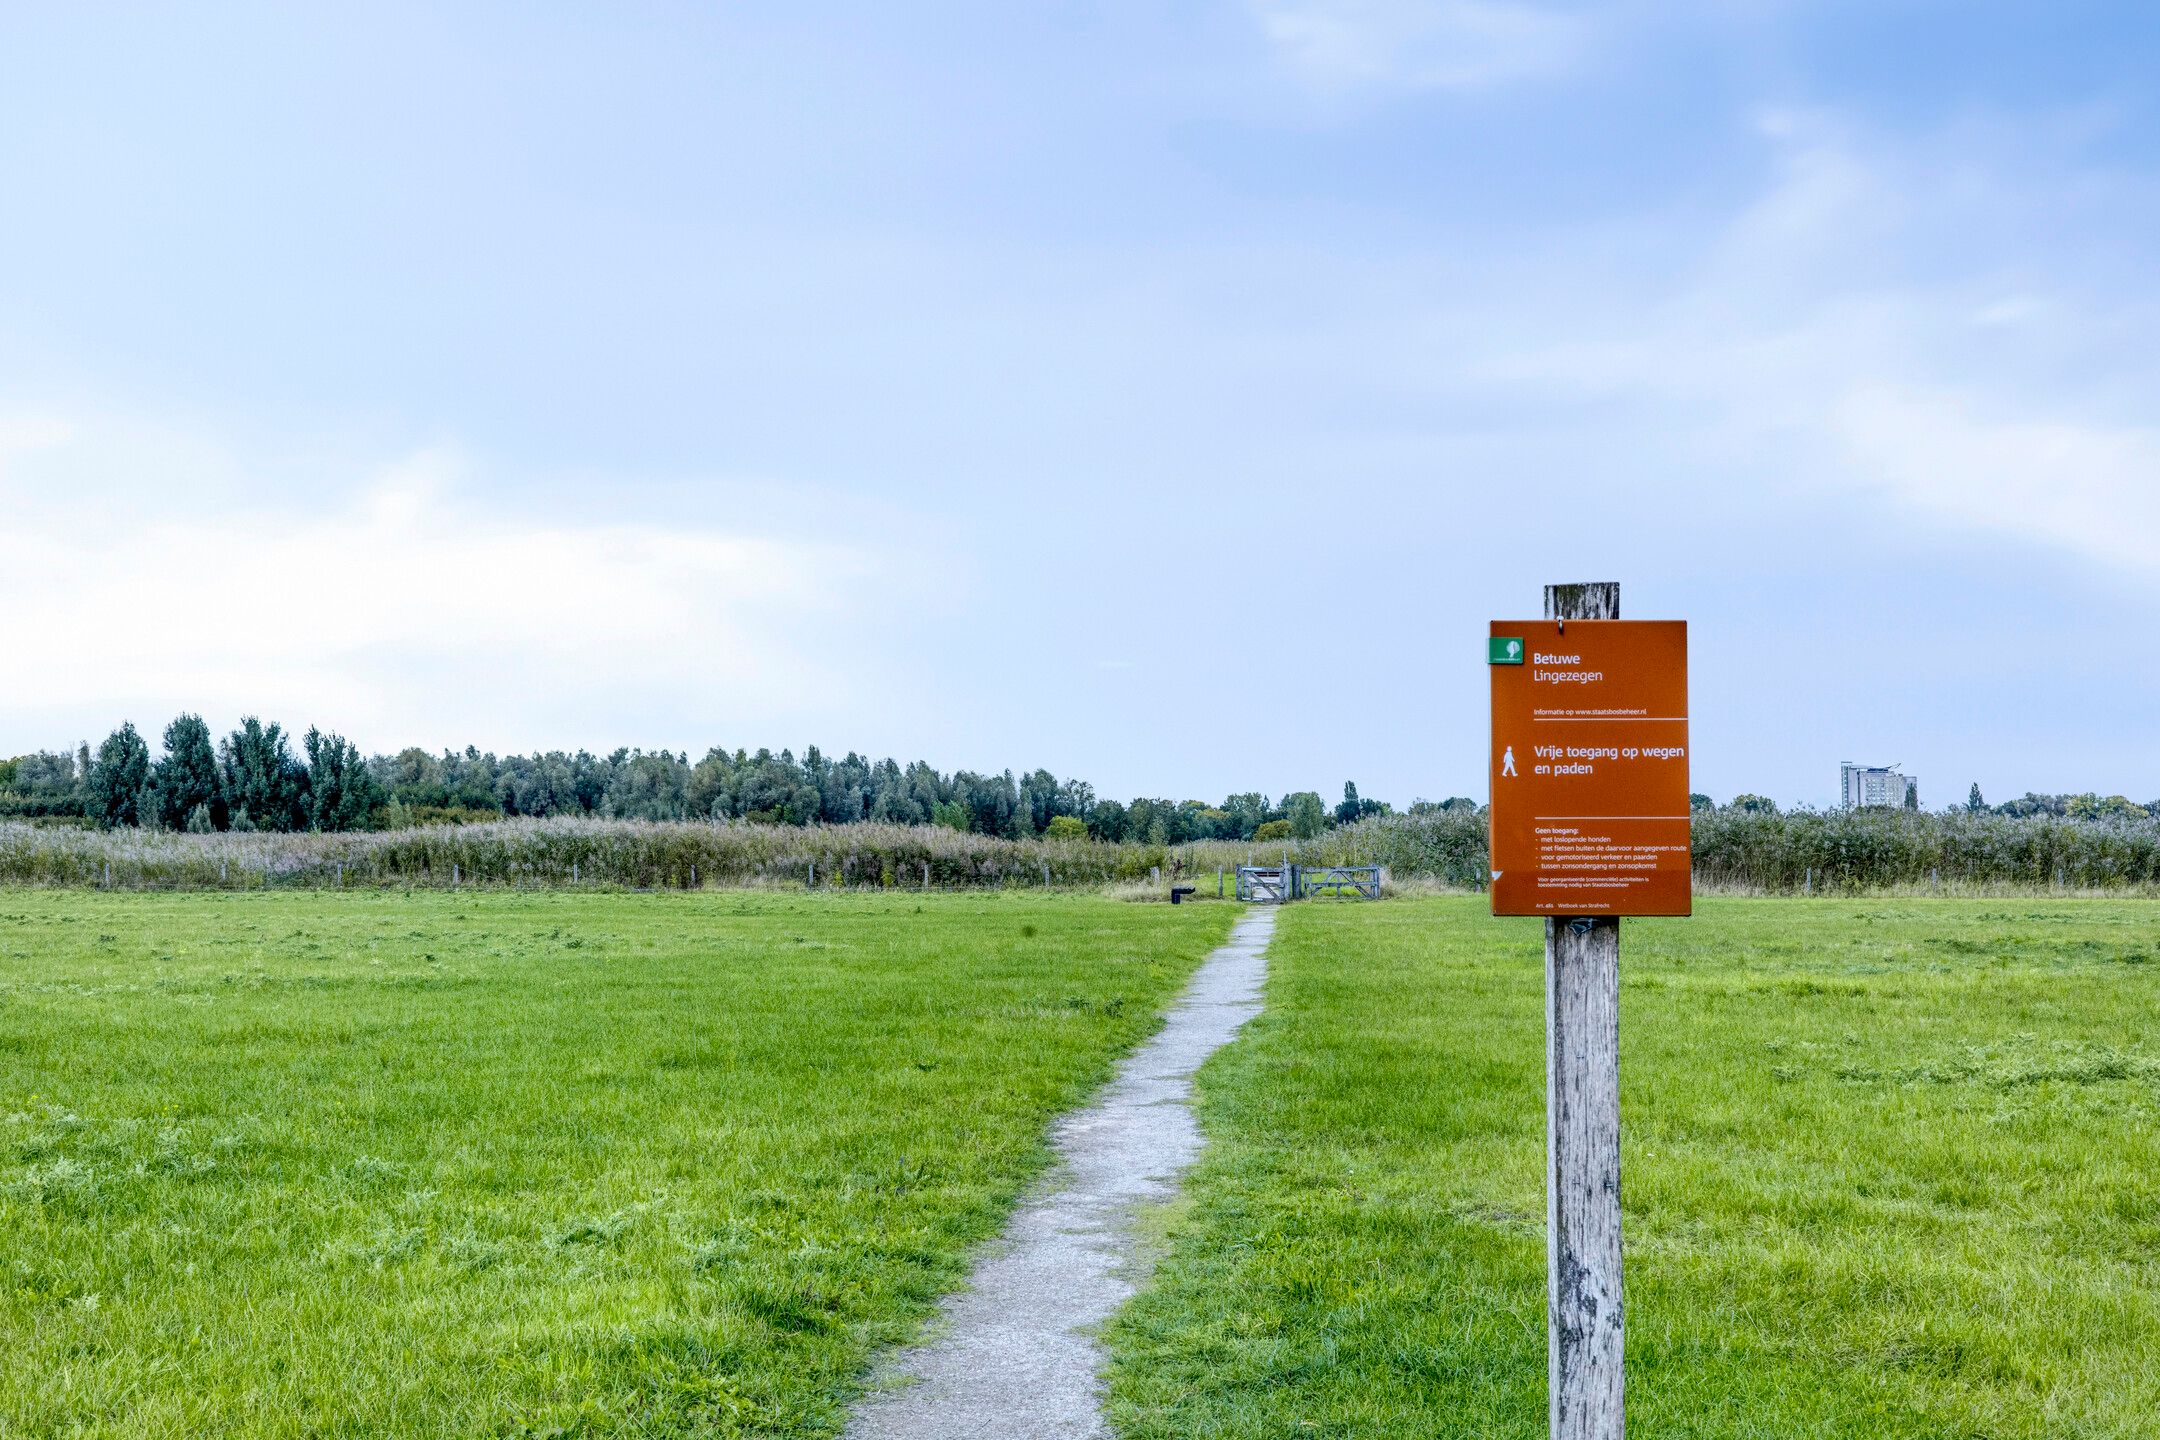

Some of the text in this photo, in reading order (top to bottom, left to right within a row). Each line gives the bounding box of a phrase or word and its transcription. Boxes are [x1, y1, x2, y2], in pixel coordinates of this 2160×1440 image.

[1534, 652, 1580, 664] Betuwe
[1534, 670, 1602, 684] Lingezegen
[1534, 746, 1684, 760] Vrije toegang op wegen
[1534, 762, 1593, 776] en paden
